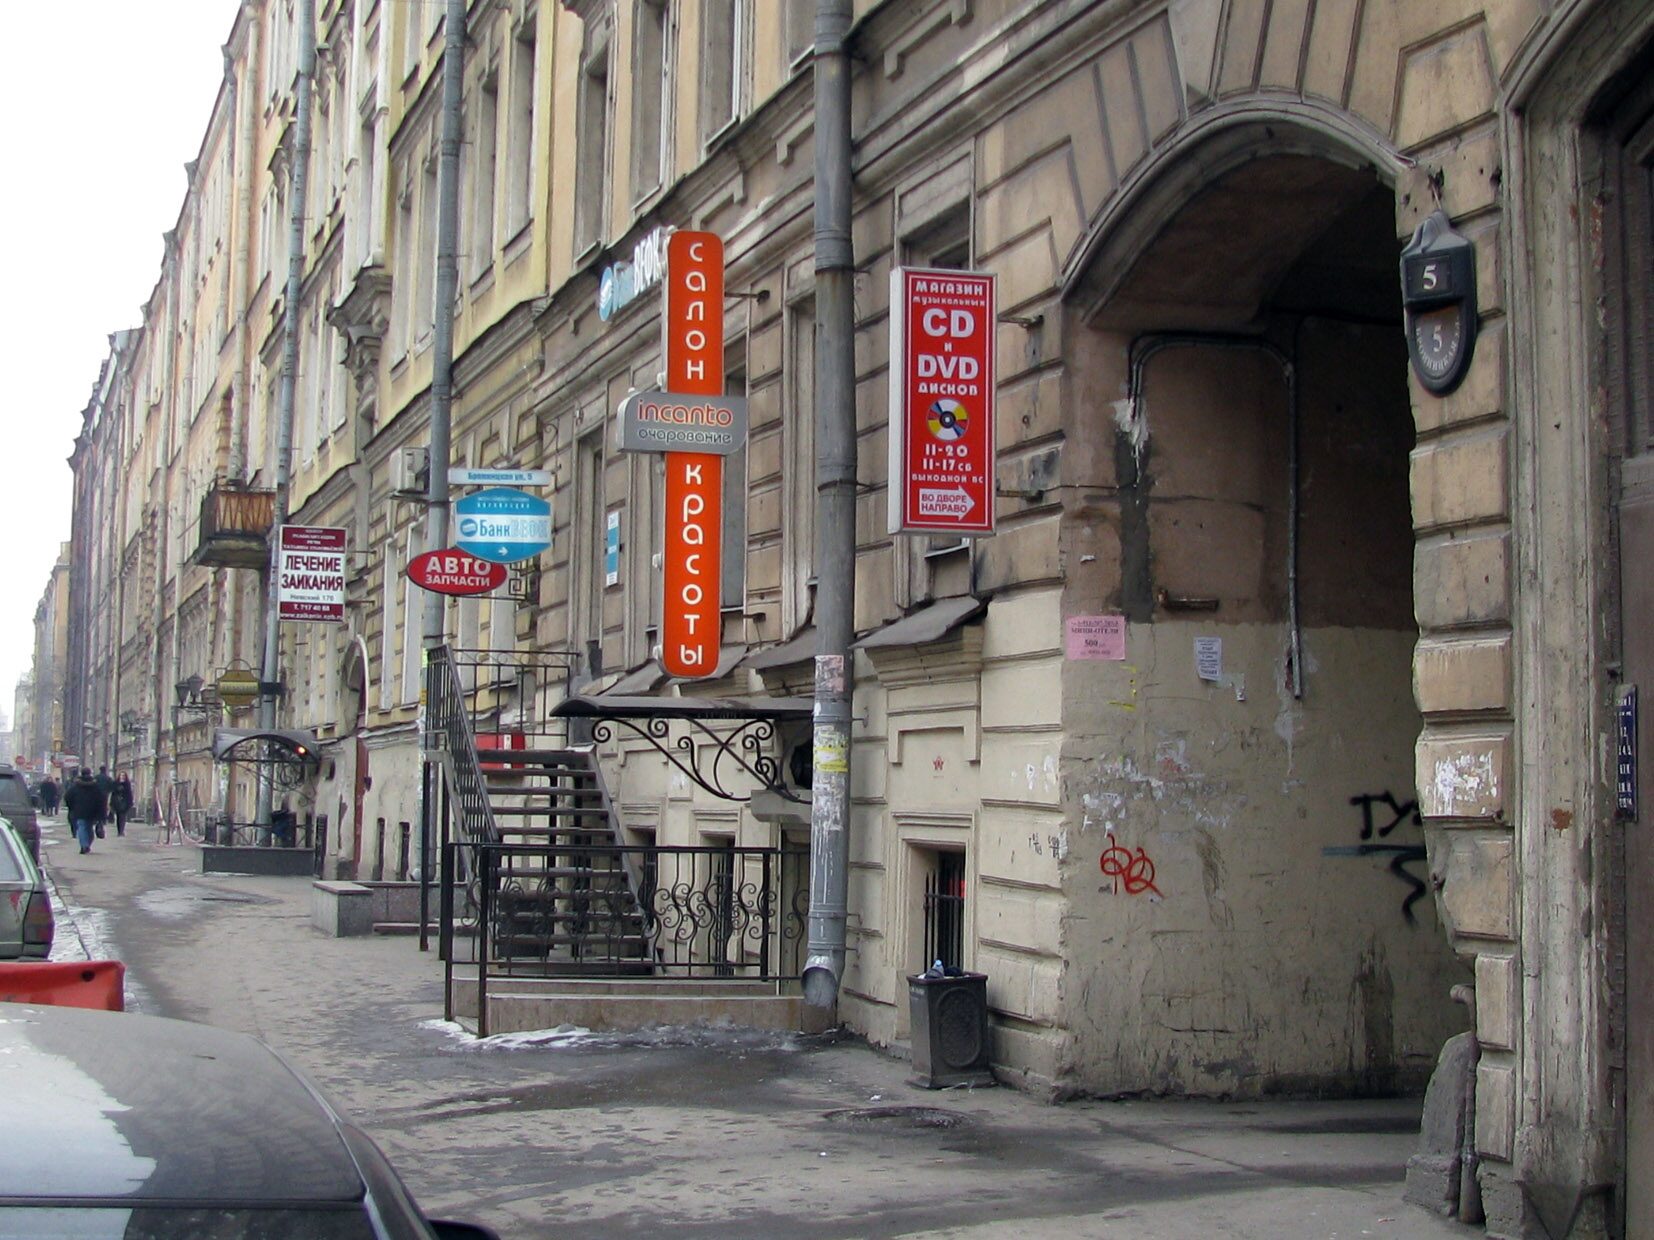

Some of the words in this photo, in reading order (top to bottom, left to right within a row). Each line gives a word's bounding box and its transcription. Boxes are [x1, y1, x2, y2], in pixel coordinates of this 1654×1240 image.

[1423, 264, 1437, 290] 5
[685, 243, 707, 380] салон
[922, 307, 975, 338] CD
[1432, 324, 1442, 352] 5
[917, 354, 979, 380] DVD
[637, 399, 732, 427] incanto
[638, 428, 732, 444] очарование
[925, 443, 968, 458] 11-20
[922, 458, 956, 471] 11-17
[921, 493, 935, 502] ВО
[936, 494, 967, 503] ДВОРЕ
[921, 503, 968, 513] НАПРАВО
[479, 519, 511, 536] Банк
[285, 555, 341, 572] ЛЕЧЕНИЕ
[425, 556, 492, 576] АВТО
[679, 463, 704, 665] красоты
[281, 574, 343, 591] ЗАИКАНИЯ
[425, 574, 490, 587] ЗАПЧАСТИ
